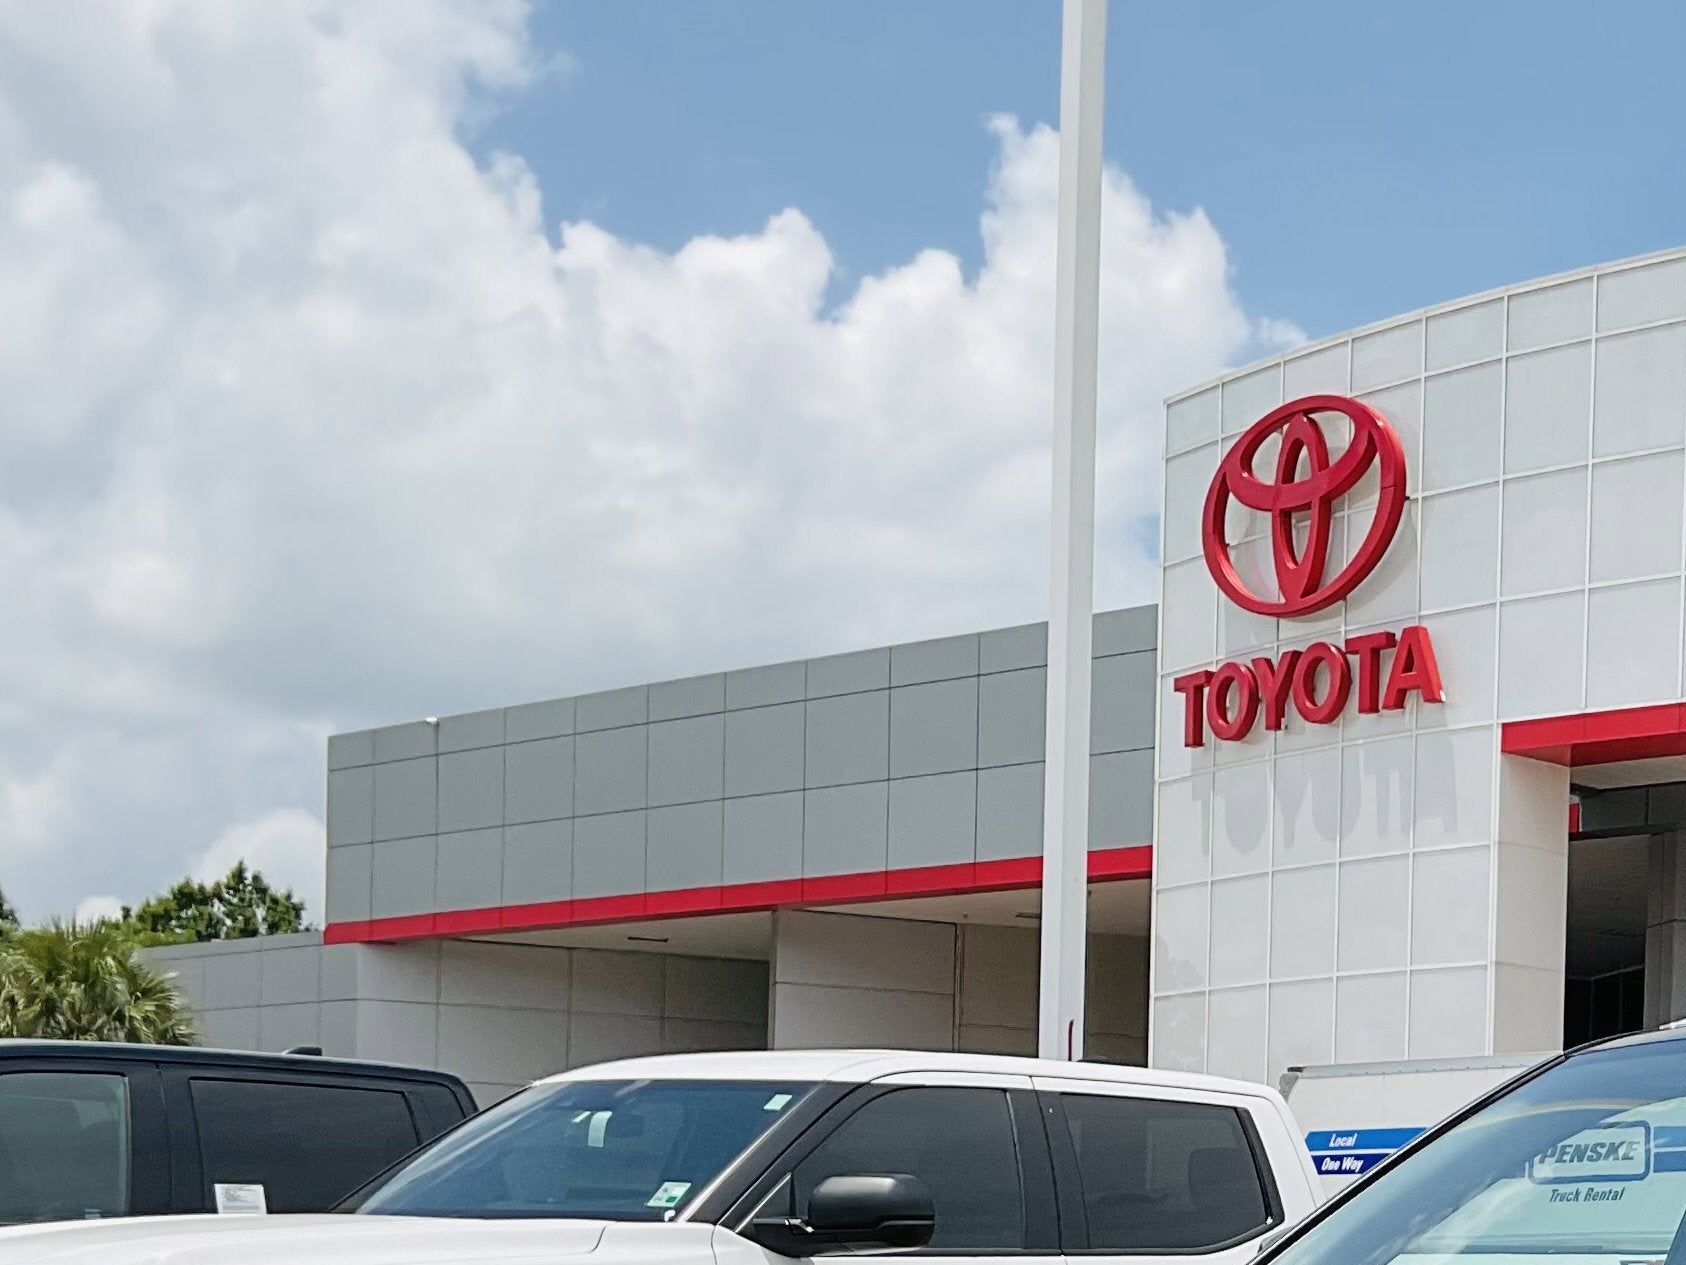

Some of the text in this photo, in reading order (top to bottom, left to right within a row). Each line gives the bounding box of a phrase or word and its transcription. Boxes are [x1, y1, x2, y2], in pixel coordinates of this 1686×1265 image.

[1174, 626, 1446, 747] TOYOTA
[1329, 1133, 1358, 1147] Local
[1321, 1157, 1364, 1173] One Way
[1549, 1187, 1625, 1202] Truck Rental
